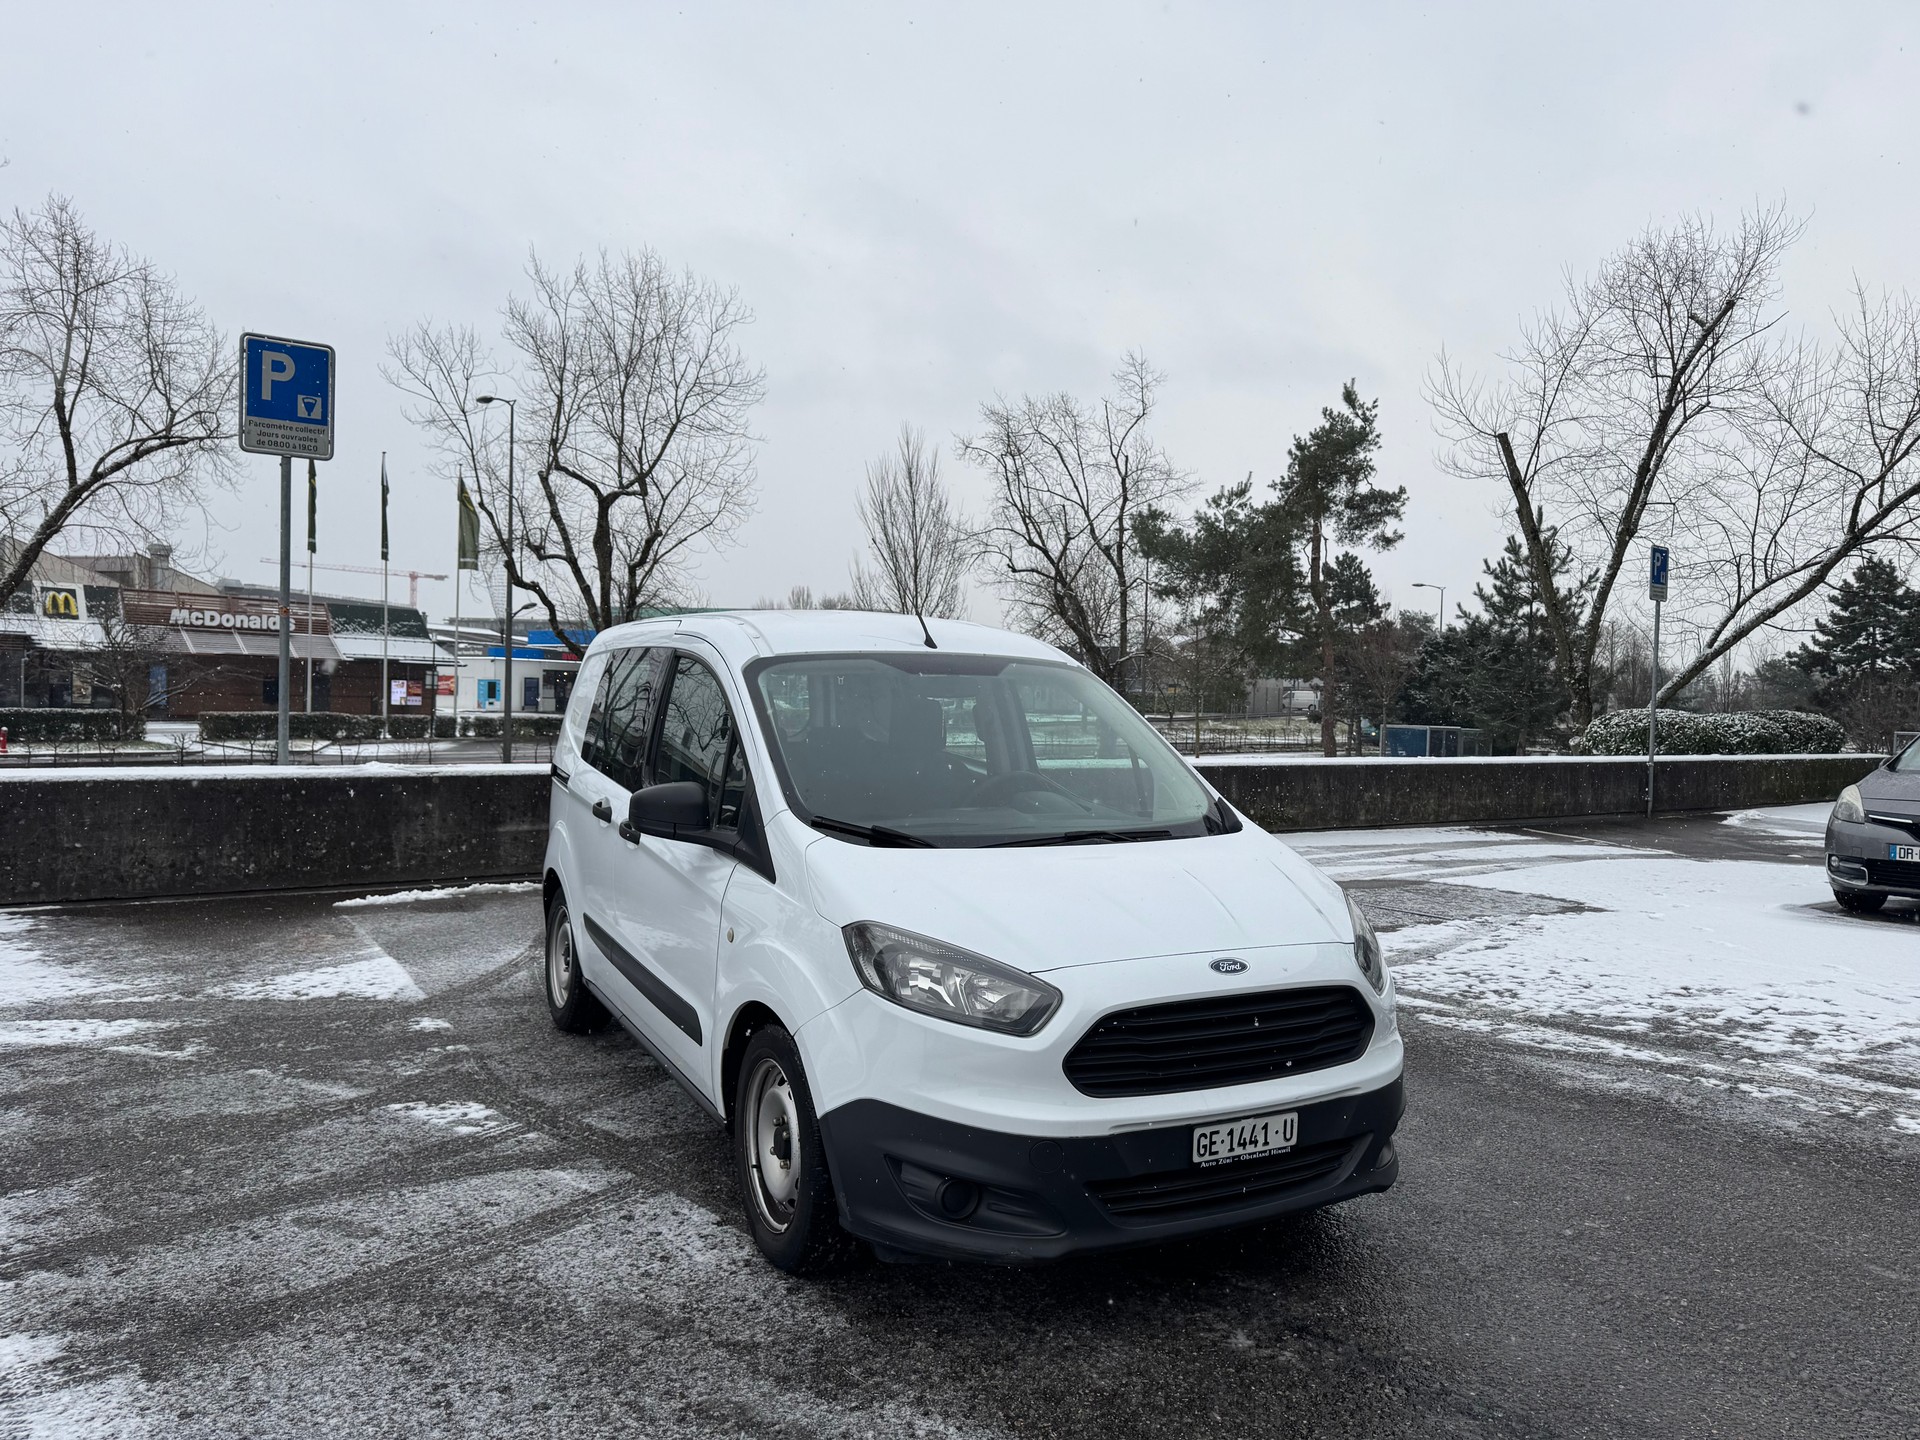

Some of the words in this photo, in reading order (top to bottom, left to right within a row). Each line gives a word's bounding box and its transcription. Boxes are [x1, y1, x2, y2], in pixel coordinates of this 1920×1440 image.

[262, 350, 295, 400] P
[248, 419, 294, 431] Parcomètre
[295, 426, 326, 435] collectif
[257, 430, 279, 438] Jours
[281, 433, 318, 443] ouvrables
[1654, 552, 1662, 576] P
[168, 608, 296, 631] McDonalds
[1898, 847, 1920, 860] DR-
[1219, 961, 1242, 972] Ford
